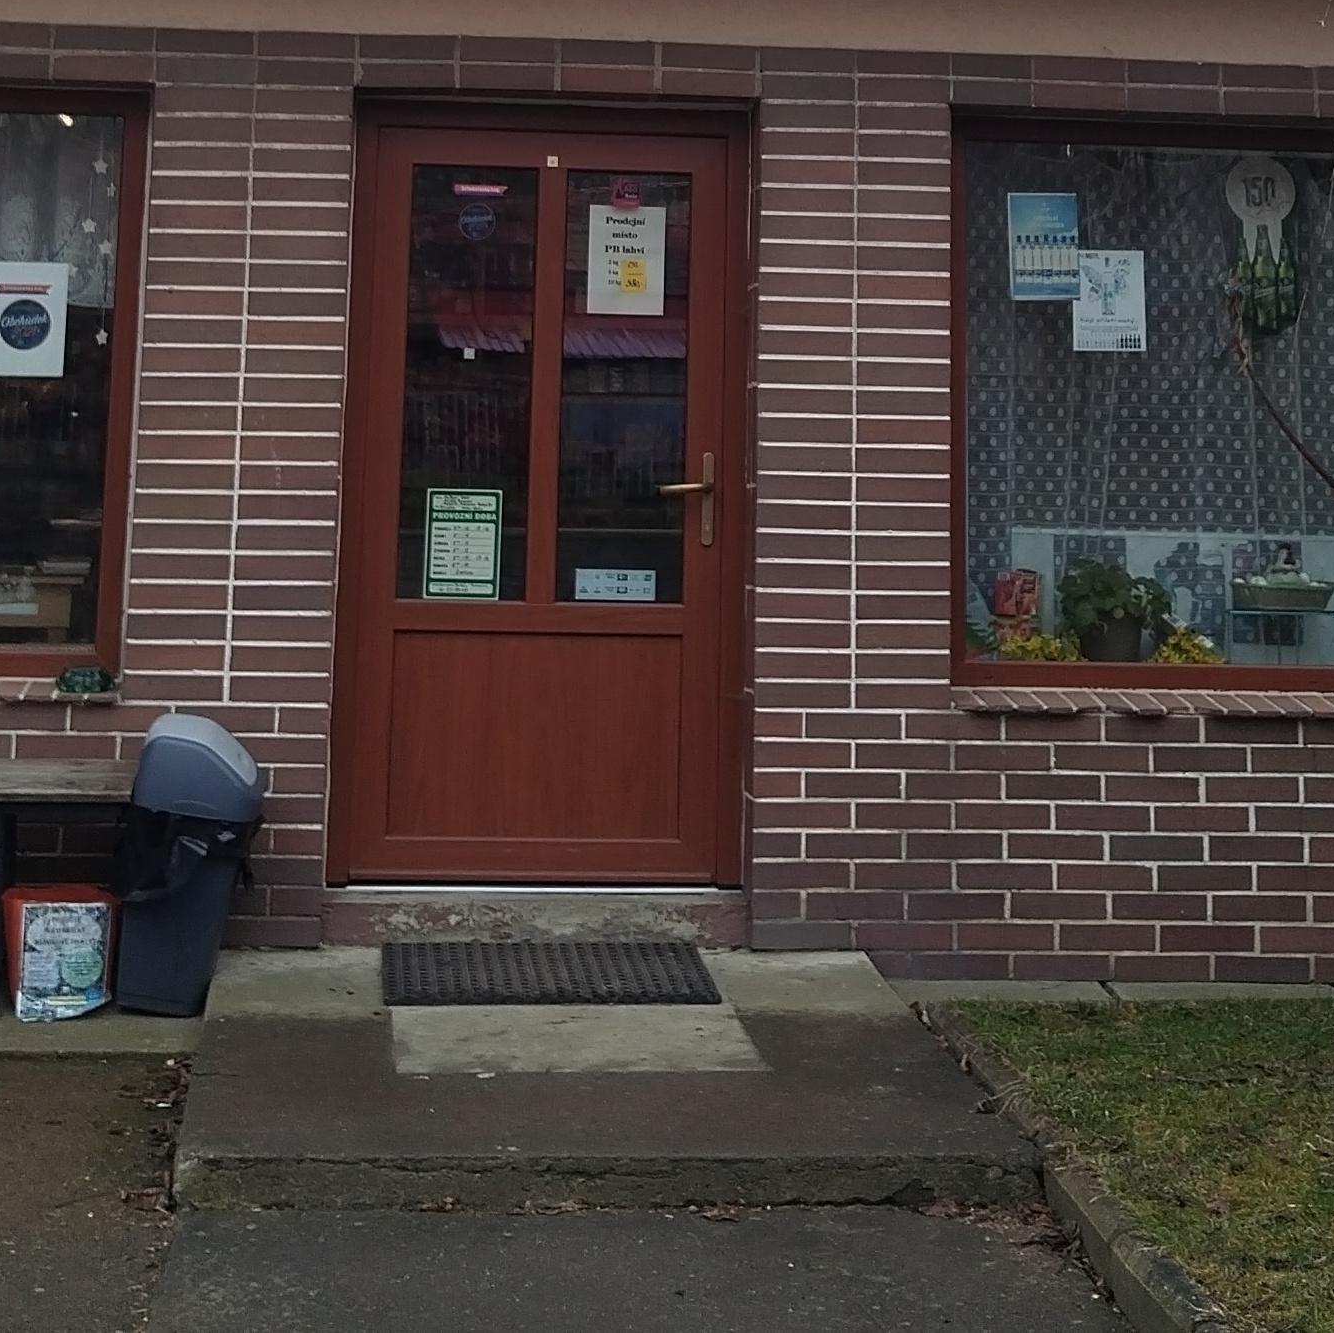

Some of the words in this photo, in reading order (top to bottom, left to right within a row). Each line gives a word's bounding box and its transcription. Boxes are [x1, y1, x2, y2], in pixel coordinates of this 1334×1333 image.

[605, 216, 646, 227] Prodejní
[612, 231, 638, 239] místo
[432, 511, 473, 520] PROVOZNÍ
[474, 513, 497, 521] DOBA
